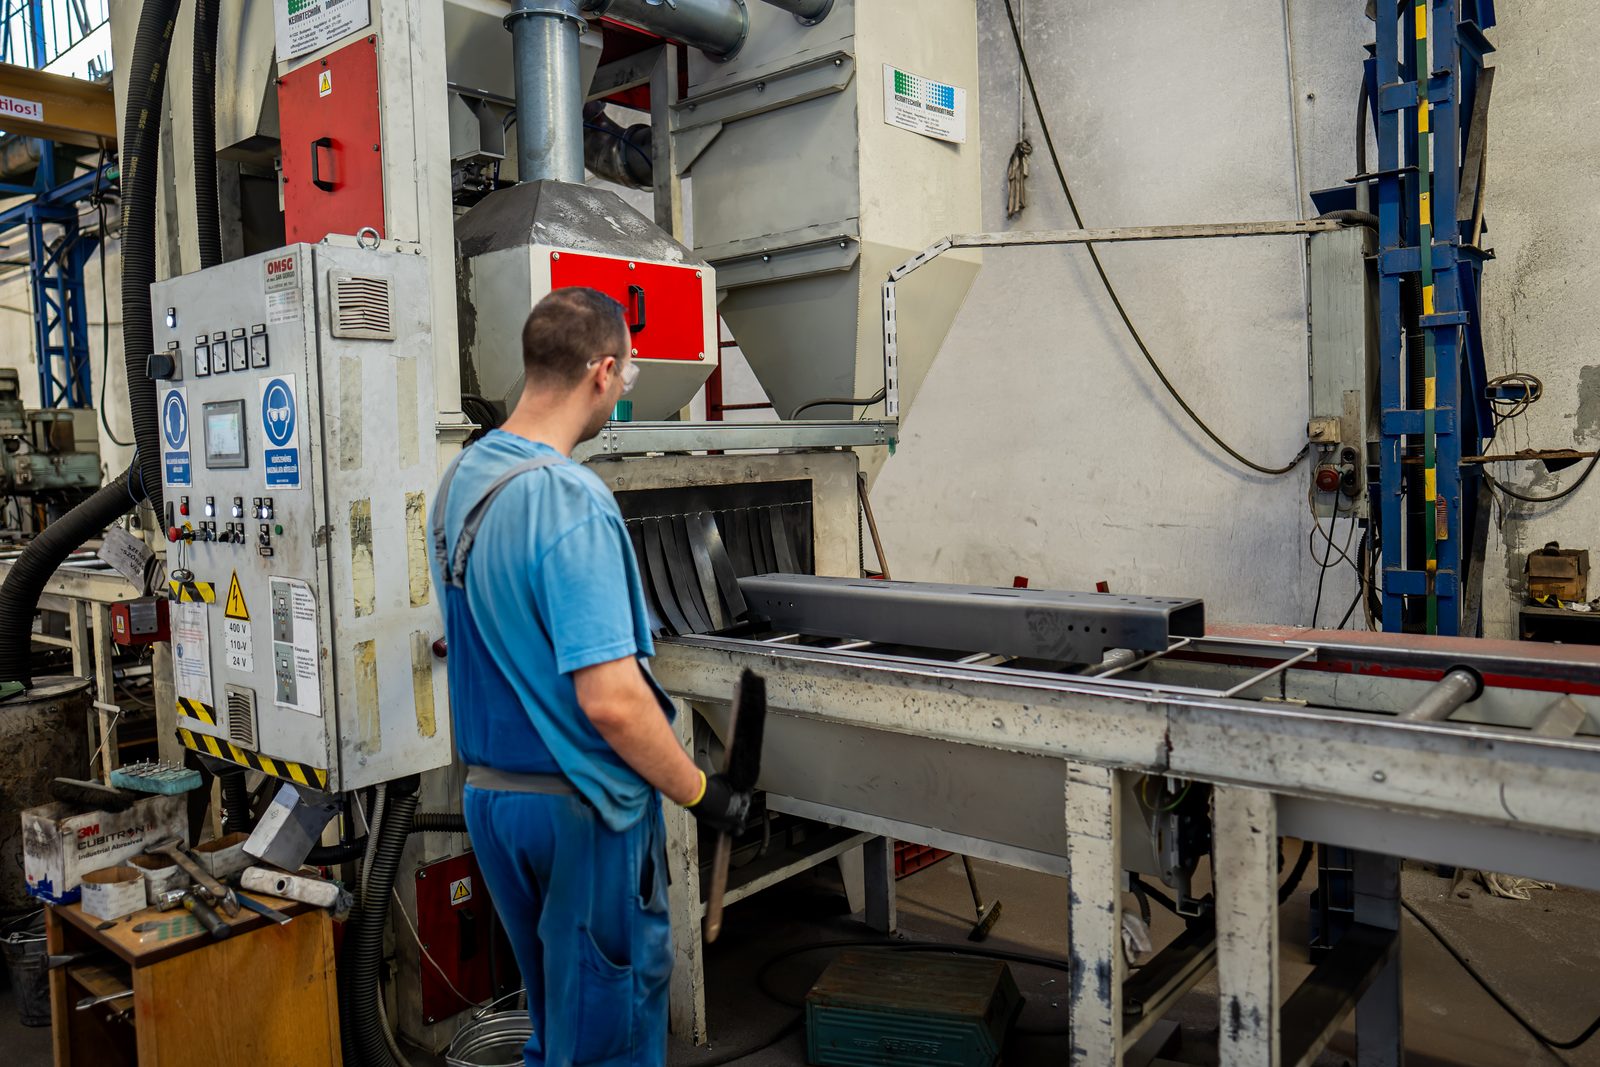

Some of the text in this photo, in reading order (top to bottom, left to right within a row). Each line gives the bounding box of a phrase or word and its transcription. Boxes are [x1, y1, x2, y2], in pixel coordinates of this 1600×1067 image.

[267, 257, 293, 275] OMSG
[229, 622, 247, 634] 400 V
[232, 656, 247, 667] 24 V
[76, 823, 100, 840] 3M
[78, 837, 144, 861] Industrial Abrasives
